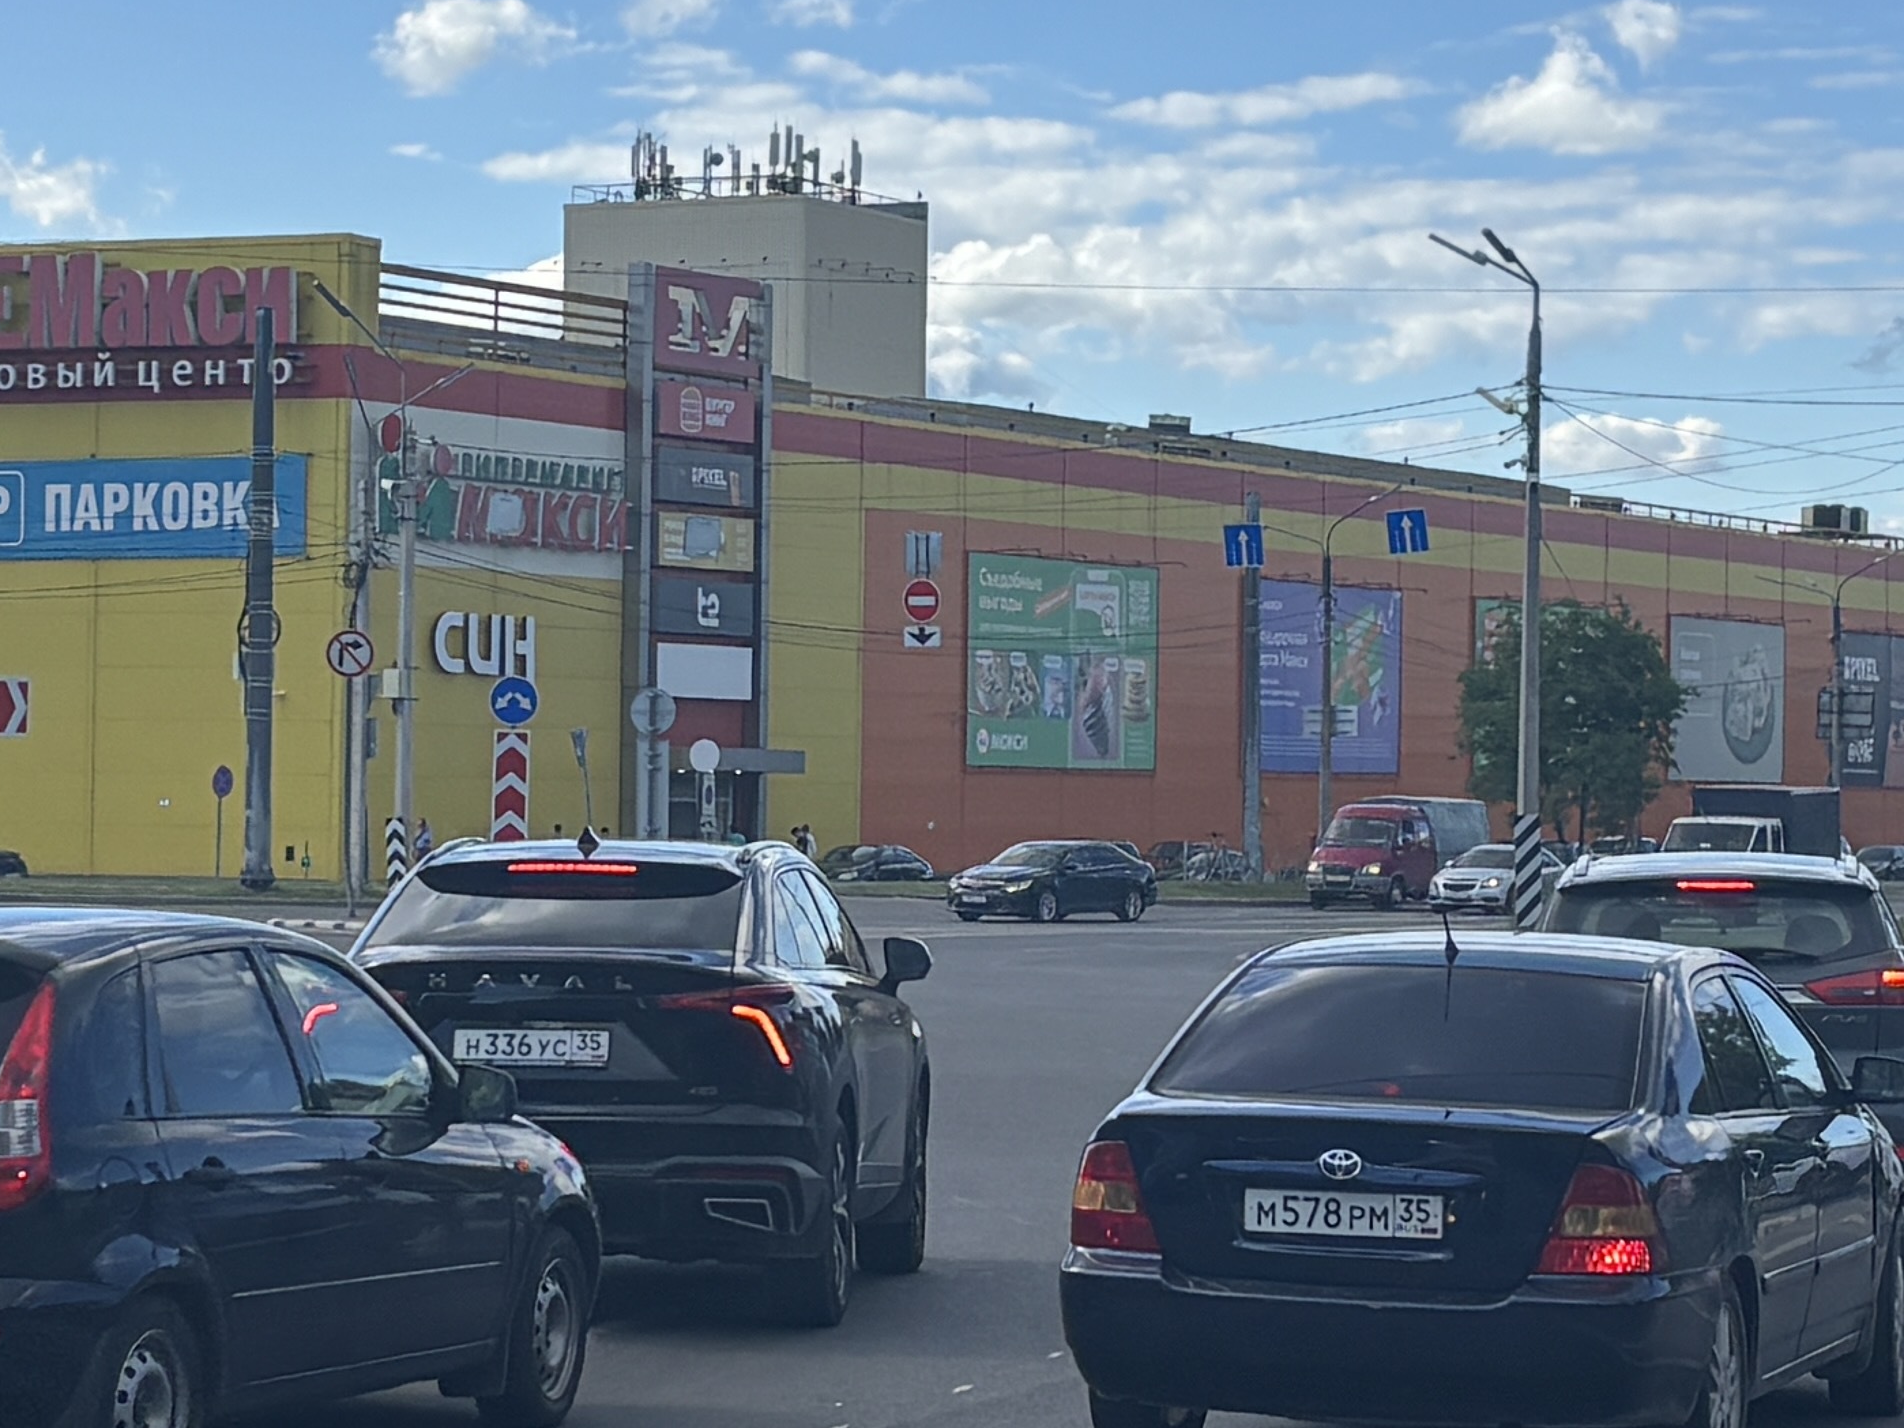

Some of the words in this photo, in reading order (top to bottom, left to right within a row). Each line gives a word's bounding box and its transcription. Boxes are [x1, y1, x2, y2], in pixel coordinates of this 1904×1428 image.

[28, 252, 298, 349] Макси
[44, 480, 280, 533] ПАРКОВК
[427, 973, 633, 991] HAVAL
[576, 1033, 602, 1051] 35
[1256, 1195, 1390, 1232] М578РМ
[1399, 1197, 1431, 1223] 35
